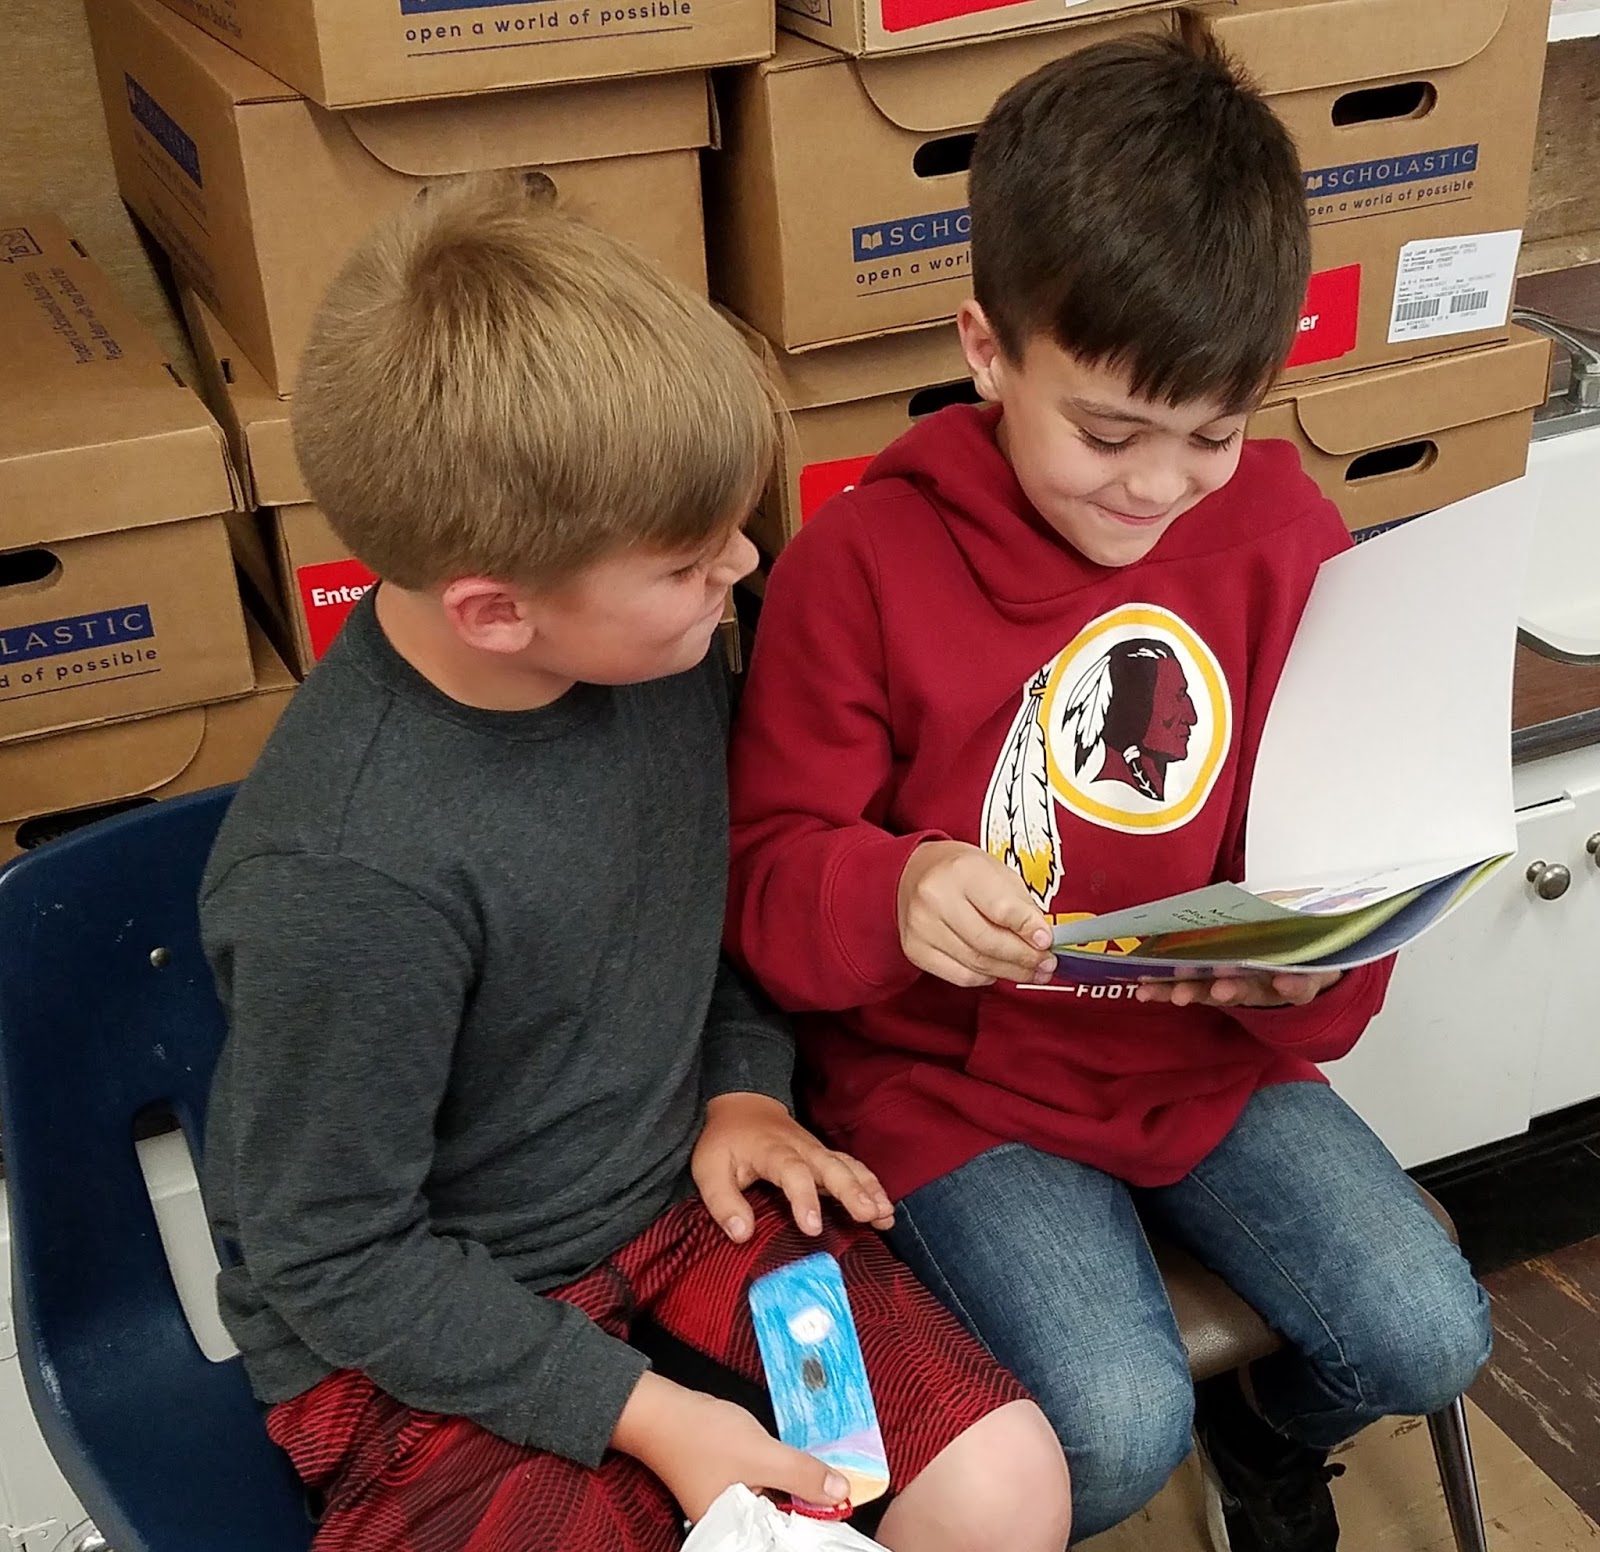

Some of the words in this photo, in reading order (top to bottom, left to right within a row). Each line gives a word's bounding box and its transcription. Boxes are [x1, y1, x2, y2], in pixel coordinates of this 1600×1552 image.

[405, 24, 462, 42] open
[472, 21, 484, 35] a
[495, 11, 559, 32] world
[569, 9, 590, 25] of
[600, 0, 692, 25] possible
[1327, 150, 1474, 188] SCHOLASTIC
[1339, 203, 1347, 212] a
[1353, 192, 1393, 209] world
[1398, 190, 1412, 201] of
[1417, 179, 1475, 201] possible
[856, 266, 902, 285] open
[910, 263, 920, 274] a
[929, 250, 970, 270] worl
[1297, 314, 1319, 332] er
[21, 667, 44, 684] of
[56, 649, 157, 680] possible
[1076, 984, 1139, 999] FOOT
